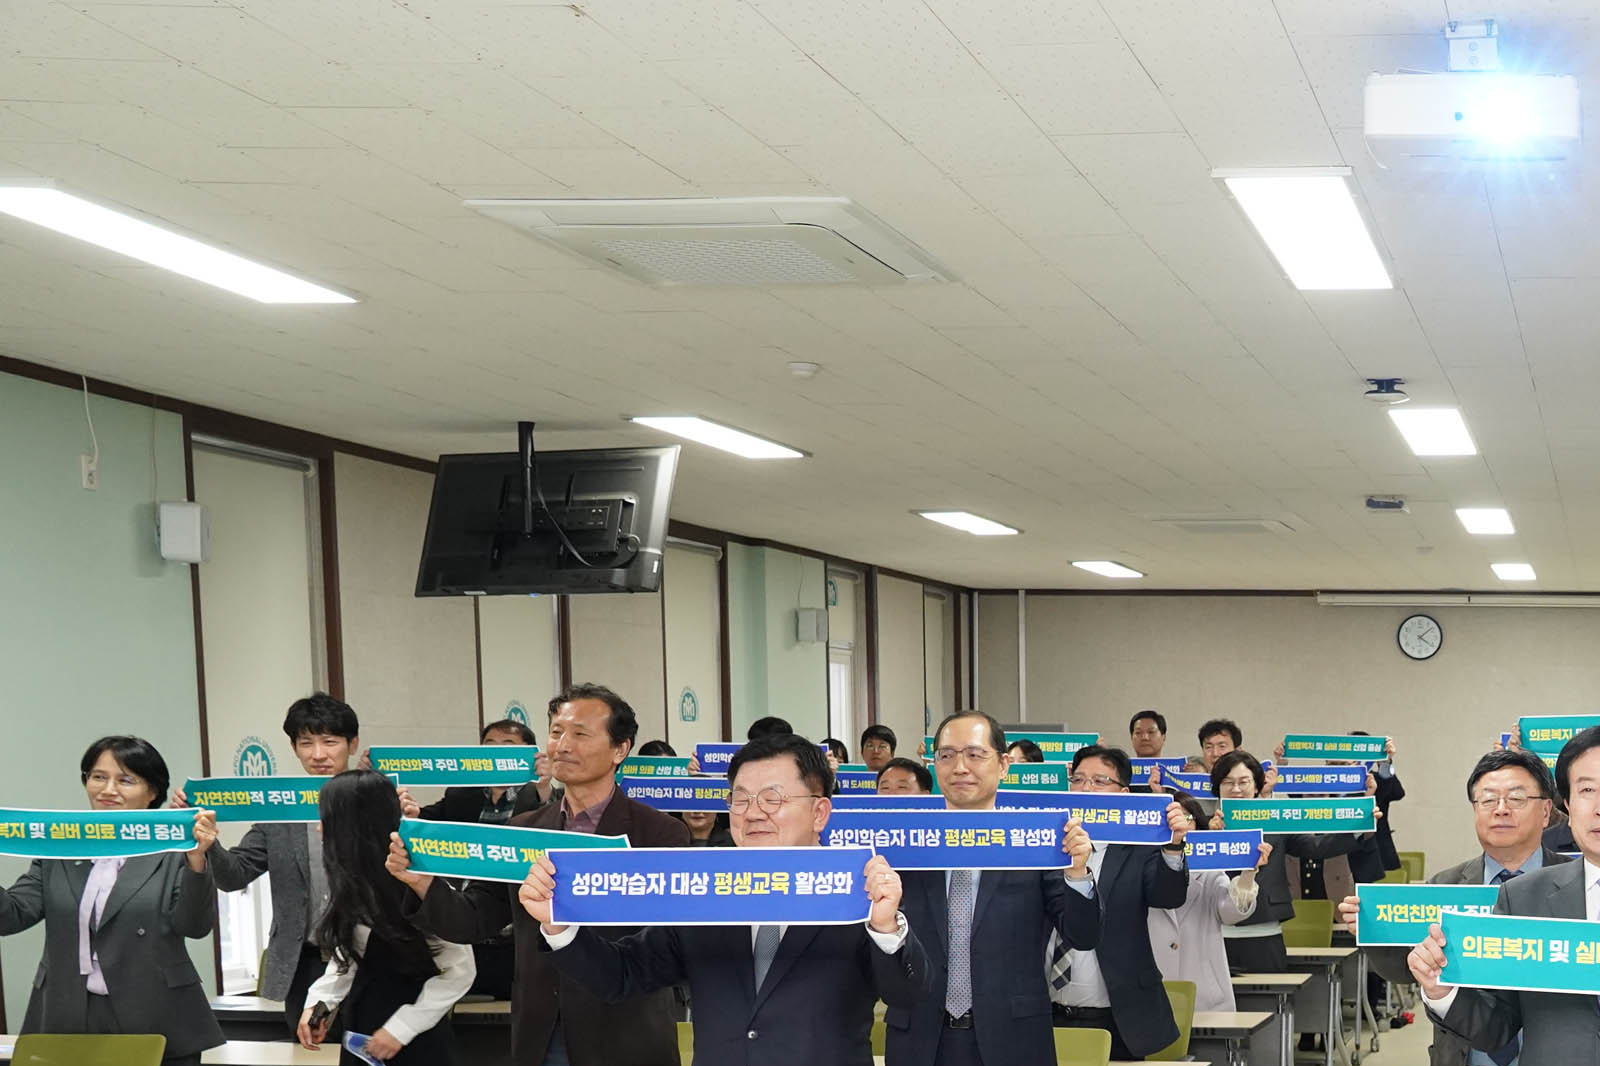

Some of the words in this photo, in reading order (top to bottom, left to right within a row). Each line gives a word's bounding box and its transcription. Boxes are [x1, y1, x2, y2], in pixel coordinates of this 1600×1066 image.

[1529, 728, 1572, 741] 의료복지
[378, 759, 433, 771] 자연친화적
[436, 759, 458, 771] 주민
[461, 759, 493, 771] 개방형
[496, 759, 529, 771] 캠퍼스
[1022, 774, 1039, 784] 산업
[1041, 774, 1059, 784] 중심
[1324, 774, 1338, 783] 연구
[1339, 774, 1361, 783] 특성화
[194, 791, 265, 806] 자연친화적
[268, 791, 296, 805] 주민
[627, 787, 673, 798] 성인학습자
[675, 788, 693, 798] 대상
[1071, 808, 1121, 824] 평생교육
[1124, 810, 1162, 826] 활성화
[1231, 809, 1280, 821] 자연친화적
[1282, 809, 1302, 820] 주민
[1304, 808, 1333, 820] 개방형
[1335, 808, 1364, 819] 캠퍼스
[29, 822, 46, 839] 및
[50, 823, 81, 839] 실버
[85, 823, 116, 839] 의료
[120, 823, 150, 840] 산업
[154, 824, 185, 840] 중심
[829, 829, 906, 847] 성인학습자
[910, 829, 940, 846] 대상
[944, 829, 1006, 846] 평생교육
[1010, 829, 1057, 847] 활성화
[409, 838, 484, 860] 자연친화적
[486, 845, 519, 862] 주민
[1196, 842, 1216, 855] 연구
[1219, 842, 1250, 855] 특성화
[571, 872, 665, 896] 성인학습자
[670, 872, 708, 895] 대상
[714, 872, 790, 895] 평생교육
[795, 871, 853, 895] 활성화
[1462, 936, 1543, 961] 의료복지
[1550, 940, 1569, 963] 및
